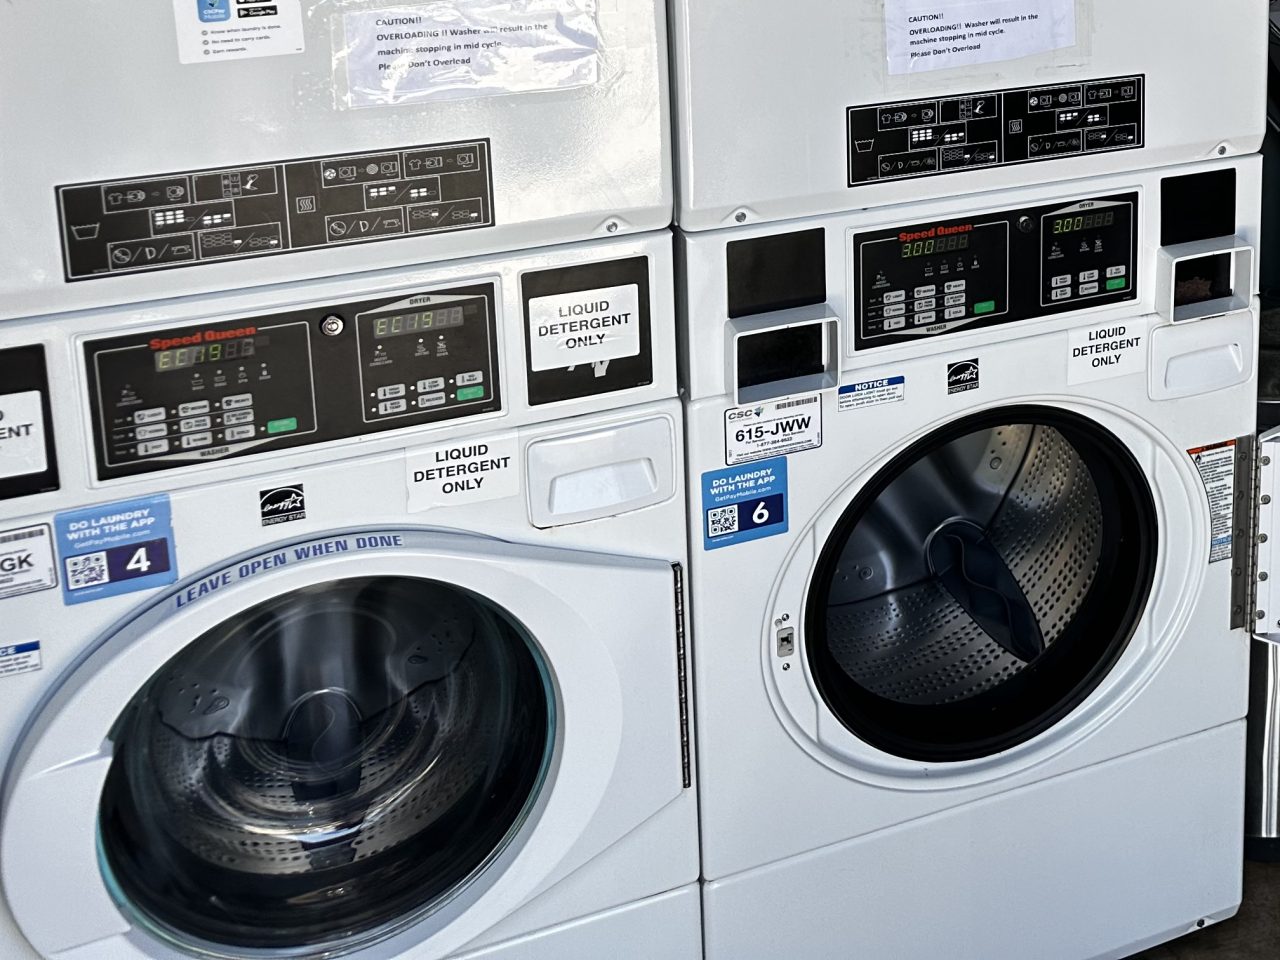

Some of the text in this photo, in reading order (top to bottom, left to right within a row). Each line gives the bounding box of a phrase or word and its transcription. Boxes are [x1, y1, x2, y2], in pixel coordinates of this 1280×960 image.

[376, 17, 422, 26] CAUTION!!
[908, 13, 944, 22] CAUTION!!
[909, 24, 962, 35] OVERLOADING!!
[965, 20, 988, 29] Washer
[1002, 16, 1019, 24] result
[377, 30, 439, 41] OVERLOADING
[910, 37, 937, 46] machine
[939, 33, 966, 43] stopping
[989, 28, 1005, 36] cycle.
[416, 45, 451, 53] stopping
[910, 44, 981, 58] Please Don't Overload
[433, 58, 470, 66] Overload
[899, 224, 972, 242] Speed Queen
[410, 296, 431, 304] DRYER
[559, 300, 610, 317] LIQUID
[539, 313, 631, 337] DETERGENT
[926, 324, 946, 332] WASHER
[150, 327, 257, 350] Speed Queen
[566, 334, 605, 349] ONLY
[1088, 327, 1126, 341] LIQUID
[1073, 337, 1141, 358] DETERGENT
[1092, 354, 1121, 368] ONLY
[855, 379, 888, 391] NOTICE
[728, 410, 753, 420] CSC
[736, 416, 811, 442] 615-JWW
[200, 446, 229, 457] WASHER
[435, 444, 488, 462] LIQUID
[414, 457, 510, 482] DETERGENT
[713, 469, 772, 487] DO LAUNDRY
[442, 477, 484, 494] ONLY
[710, 476, 775, 495] WITH THE APP
[715, 486, 771, 502] GetPayMobile.com
[69, 509, 150, 531] DO LAUNDRY
[262, 511, 306, 526] ENERGY STAR
[752, 501, 769, 524] 6
[67, 517, 155, 540] WITH THE APP
[126, 547, 151, 571] 4
[175, 535, 403, 608] LEAVE OPEN WHEN DONE
